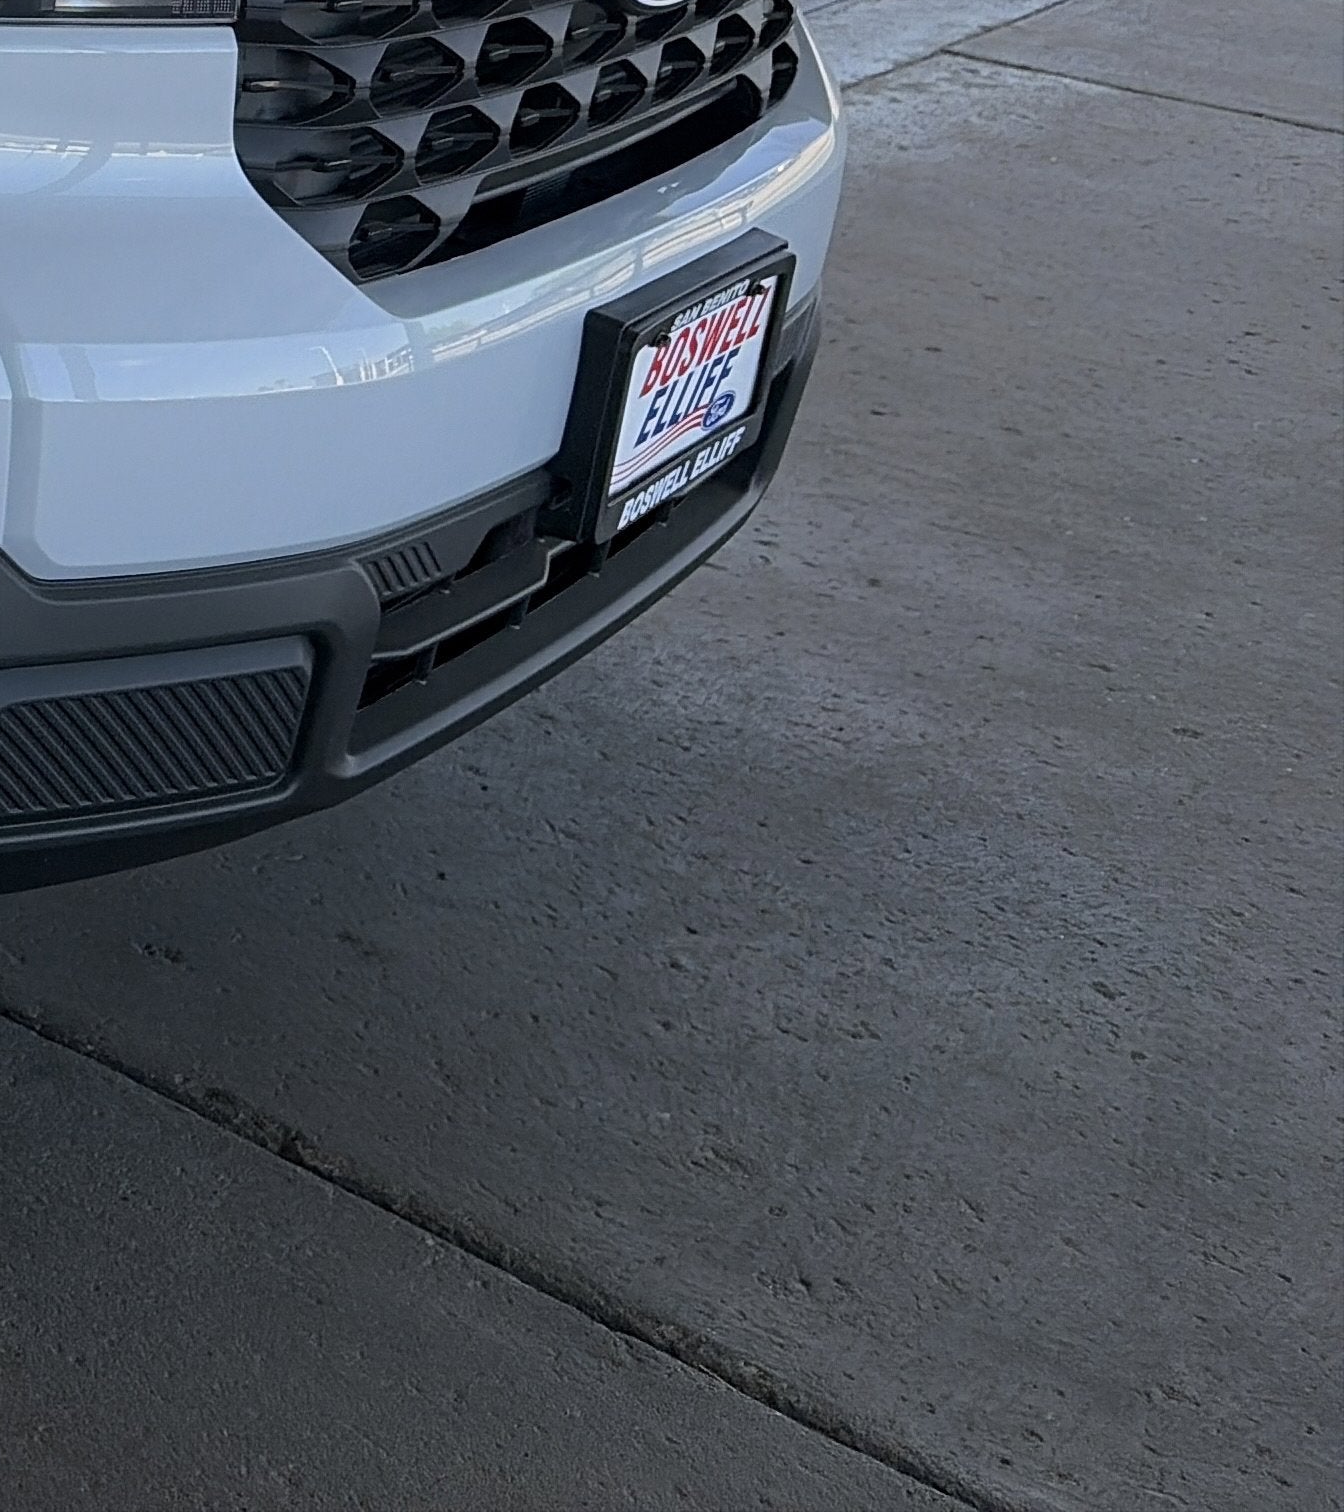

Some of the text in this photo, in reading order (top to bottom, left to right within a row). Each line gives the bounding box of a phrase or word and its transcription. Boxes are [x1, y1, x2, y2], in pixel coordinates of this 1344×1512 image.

[639, 284, 771, 399] BOSWELL
[671, 278, 751, 333] SAN BENITO
[633, 347, 739, 449] ELLIFF
[617, 425, 746, 531] BOSWELL ELLIFF
